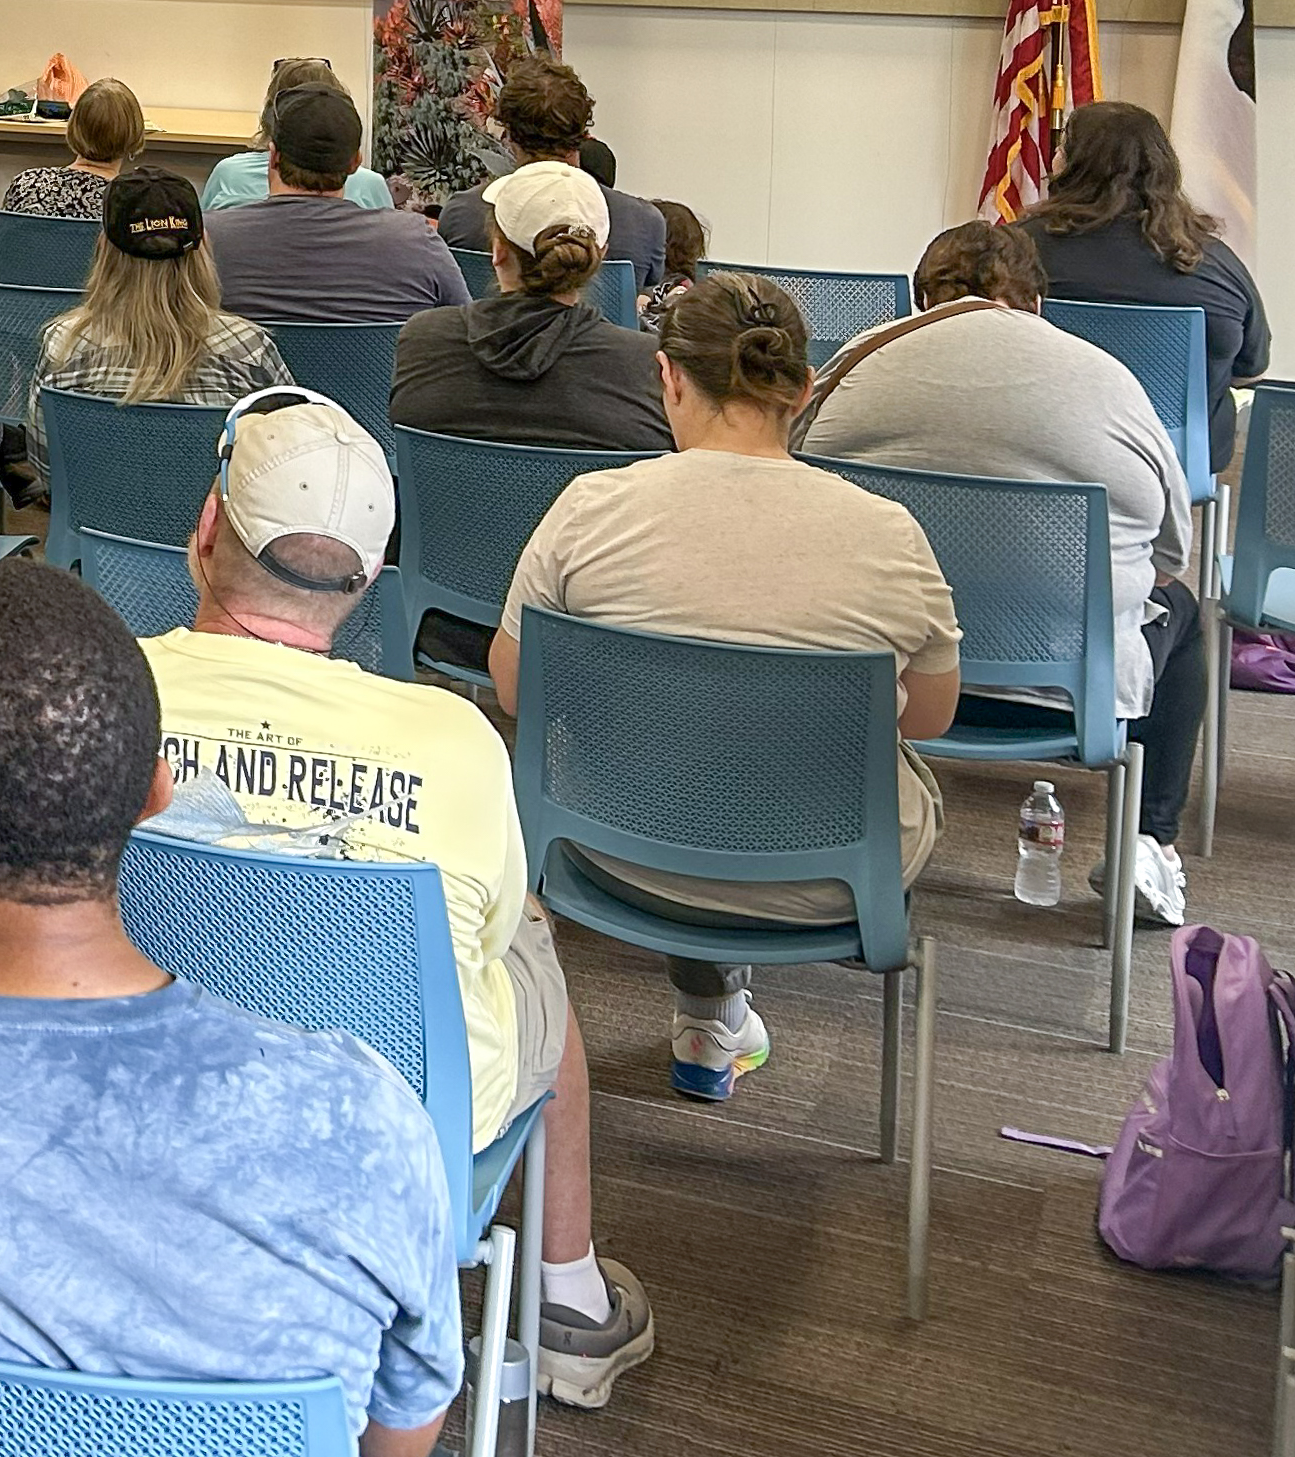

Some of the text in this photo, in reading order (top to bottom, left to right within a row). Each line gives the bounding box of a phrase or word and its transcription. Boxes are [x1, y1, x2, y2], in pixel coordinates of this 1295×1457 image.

[129, 215, 189, 233] THE LION KING
[227, 727, 303, 746] THE ART OF
[215, 744, 277, 797] AND
[286, 754, 423, 834] RELEASE
